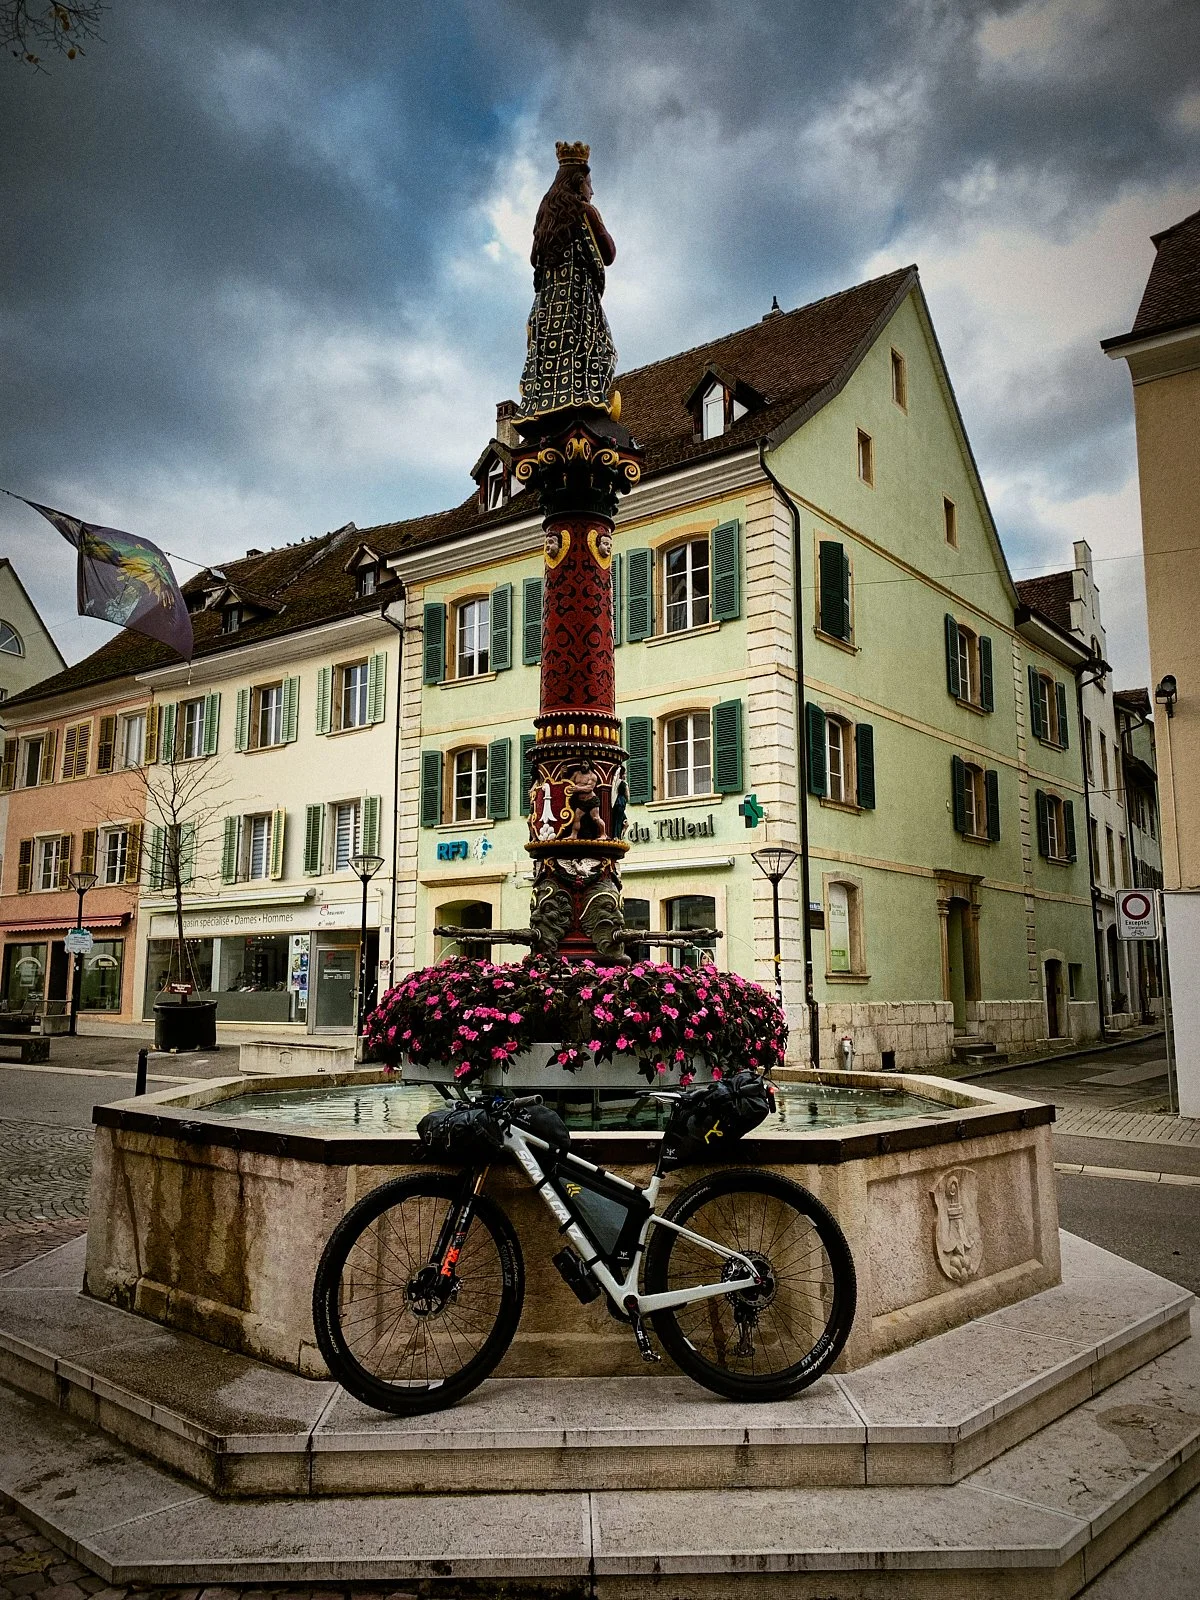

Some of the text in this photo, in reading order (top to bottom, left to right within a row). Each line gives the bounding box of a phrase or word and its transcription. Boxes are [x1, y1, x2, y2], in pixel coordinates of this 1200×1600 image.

[628, 814, 715, 842] du Tilleul
[437, 841, 468, 861] RFJ
[173, 912, 294, 931] Mgasin spécialisé Dames Hommes
[671, 1186, 711, 1223] ONTINENTAL
[801, 1333, 830, 1368] DT SWISS
